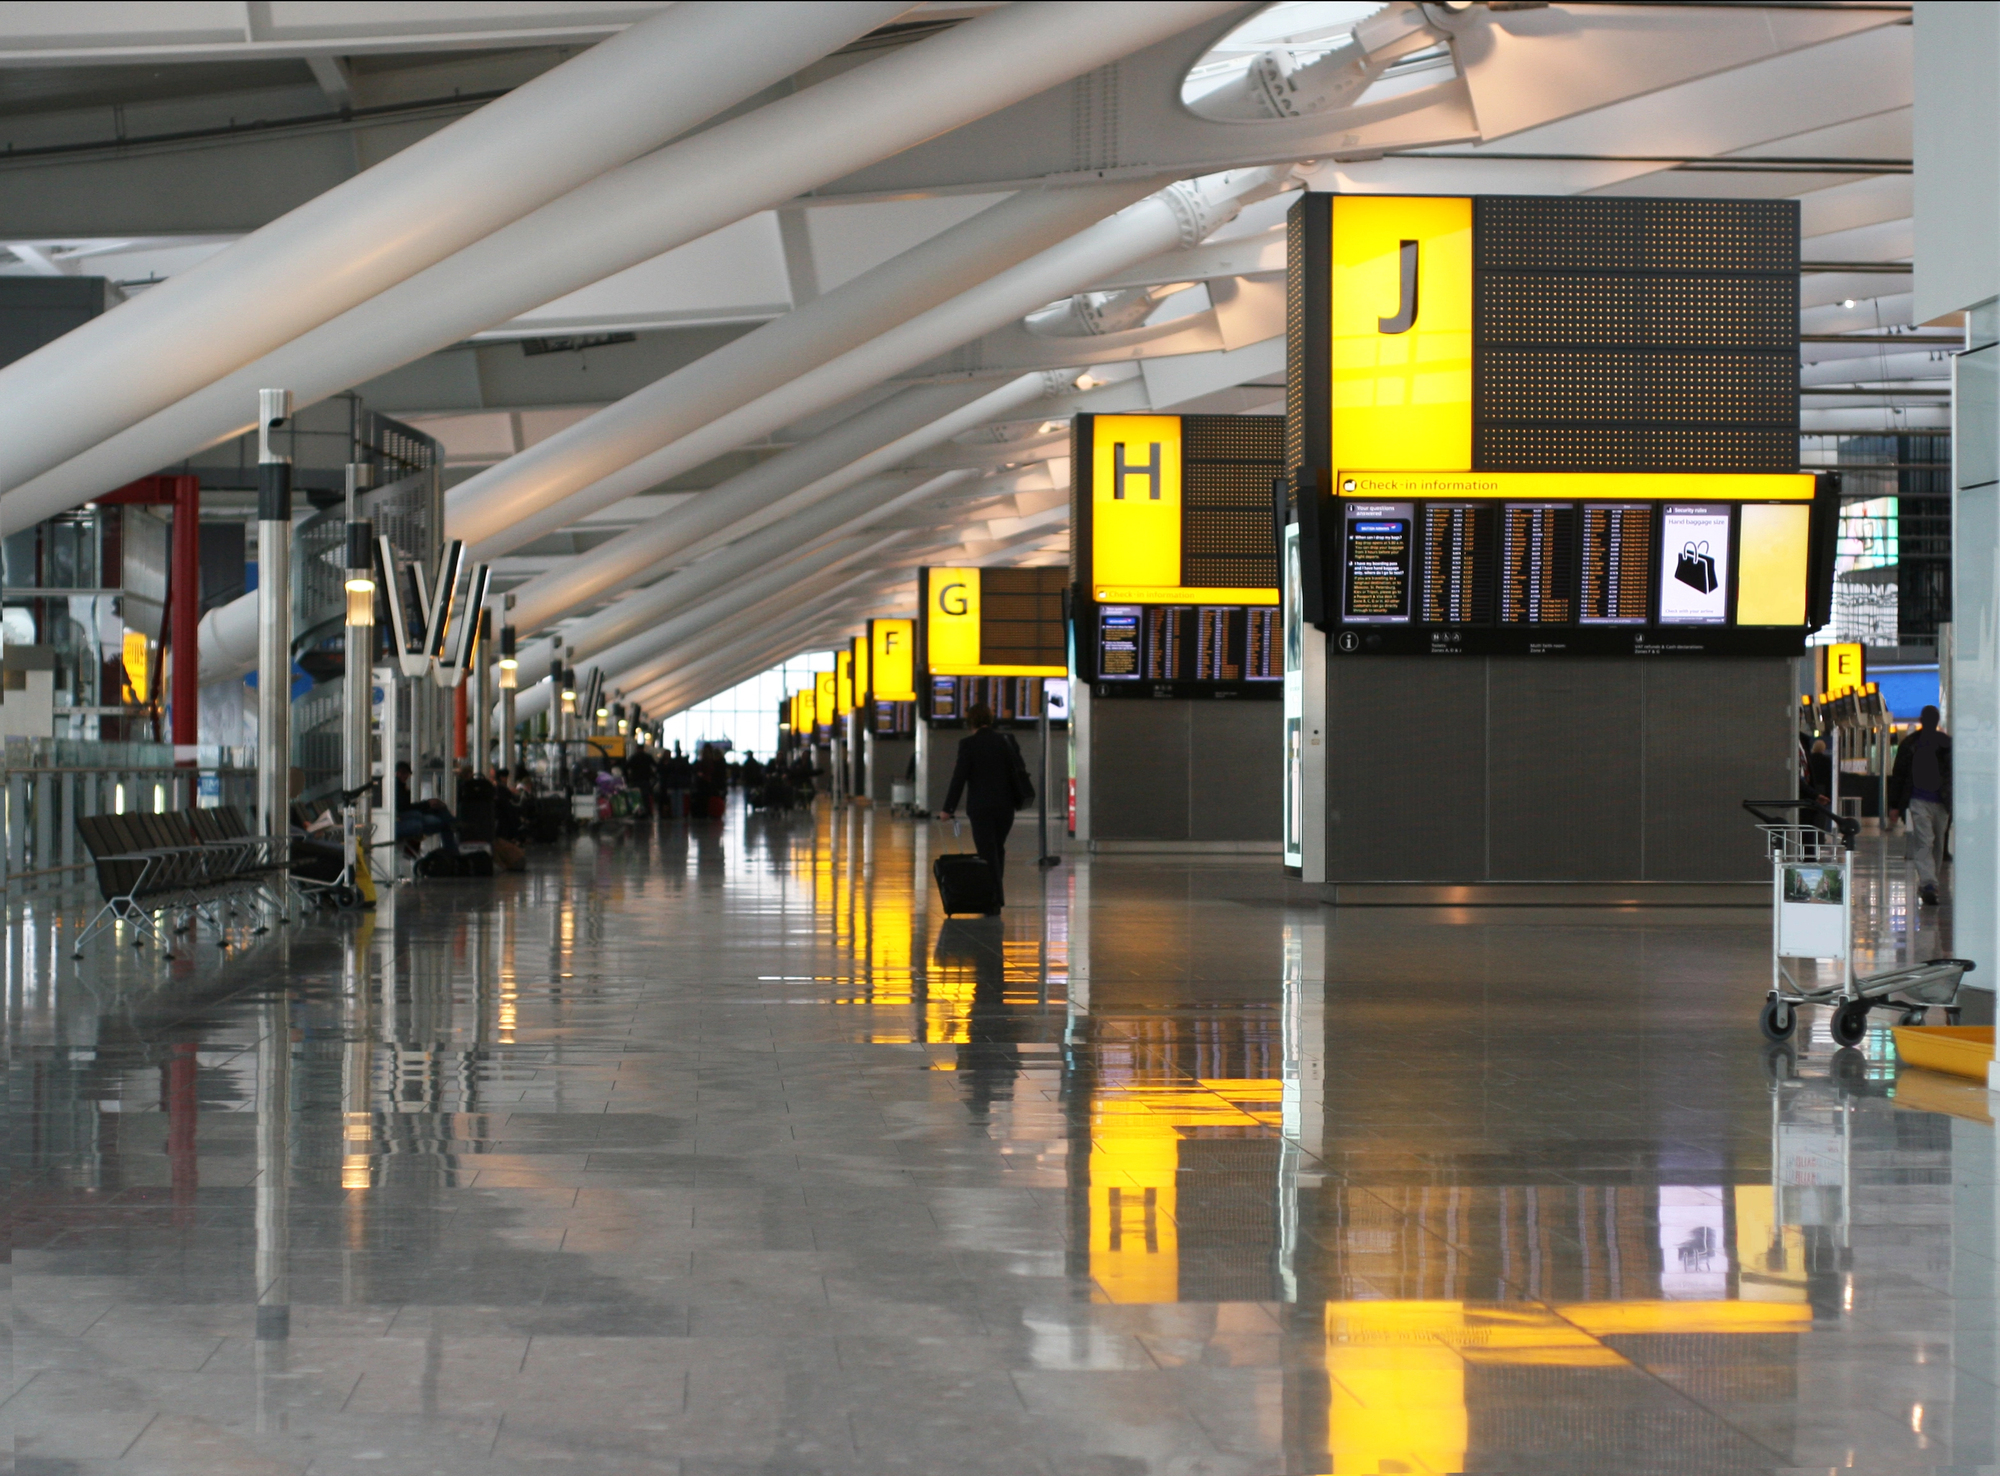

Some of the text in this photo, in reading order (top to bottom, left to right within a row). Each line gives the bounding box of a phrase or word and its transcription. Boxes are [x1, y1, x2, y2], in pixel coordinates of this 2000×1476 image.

[1378, 239, 1418, 335] J
[1113, 442, 1160, 500] H
[1360, 479, 1498, 491] Check-in information
[939, 583, 968, 616] G
[885, 631, 898, 655] F
[1839, 653, 1851, 675] E
